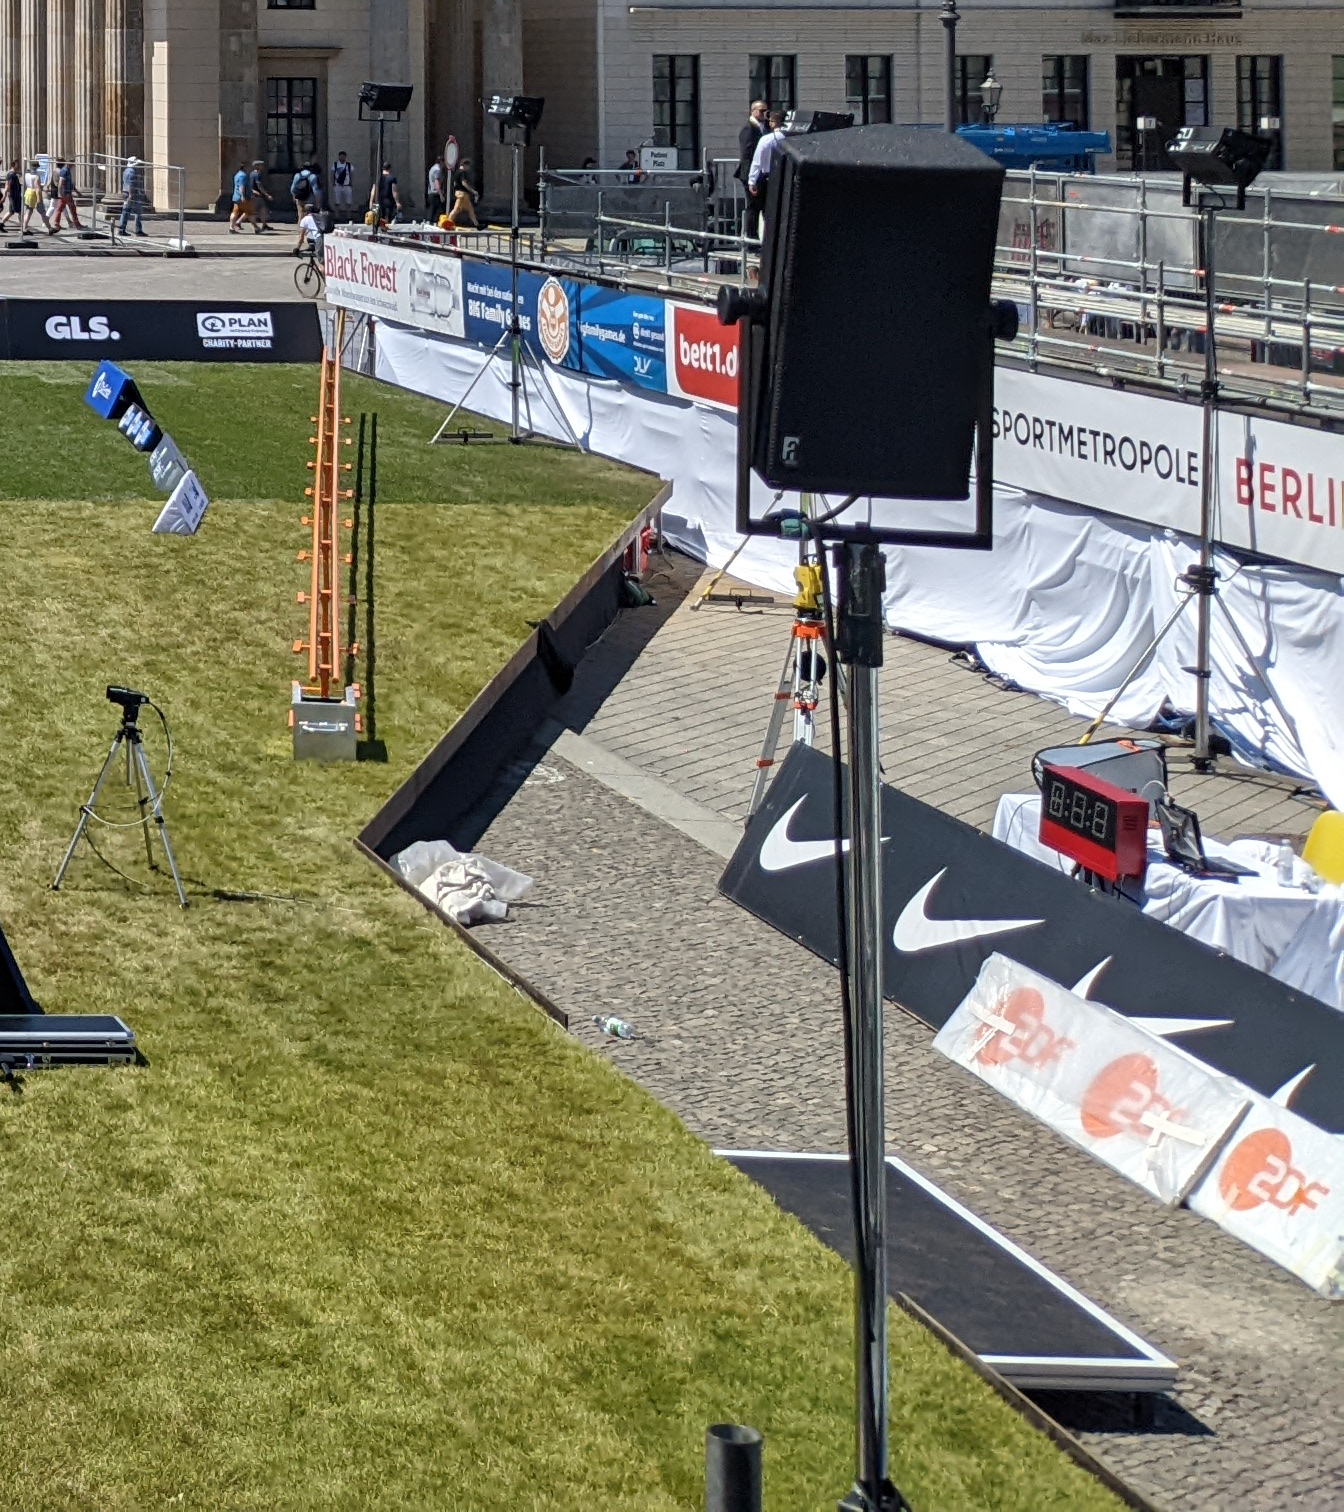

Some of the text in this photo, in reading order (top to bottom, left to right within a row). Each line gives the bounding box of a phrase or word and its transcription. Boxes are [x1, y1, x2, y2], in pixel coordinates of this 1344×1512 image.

[324, 244, 397, 294] Black Forest
[228, 317, 269, 329] PLAN
[505, 309, 530, 331] Gmes
[203, 338, 273, 348] CHARITY-PARTNER
[680, 333, 738, 378] bett1.d
[992, 407, 1199, 487] SPORTMETROPOLE
[1235, 456, 1344, 531] BERLI
